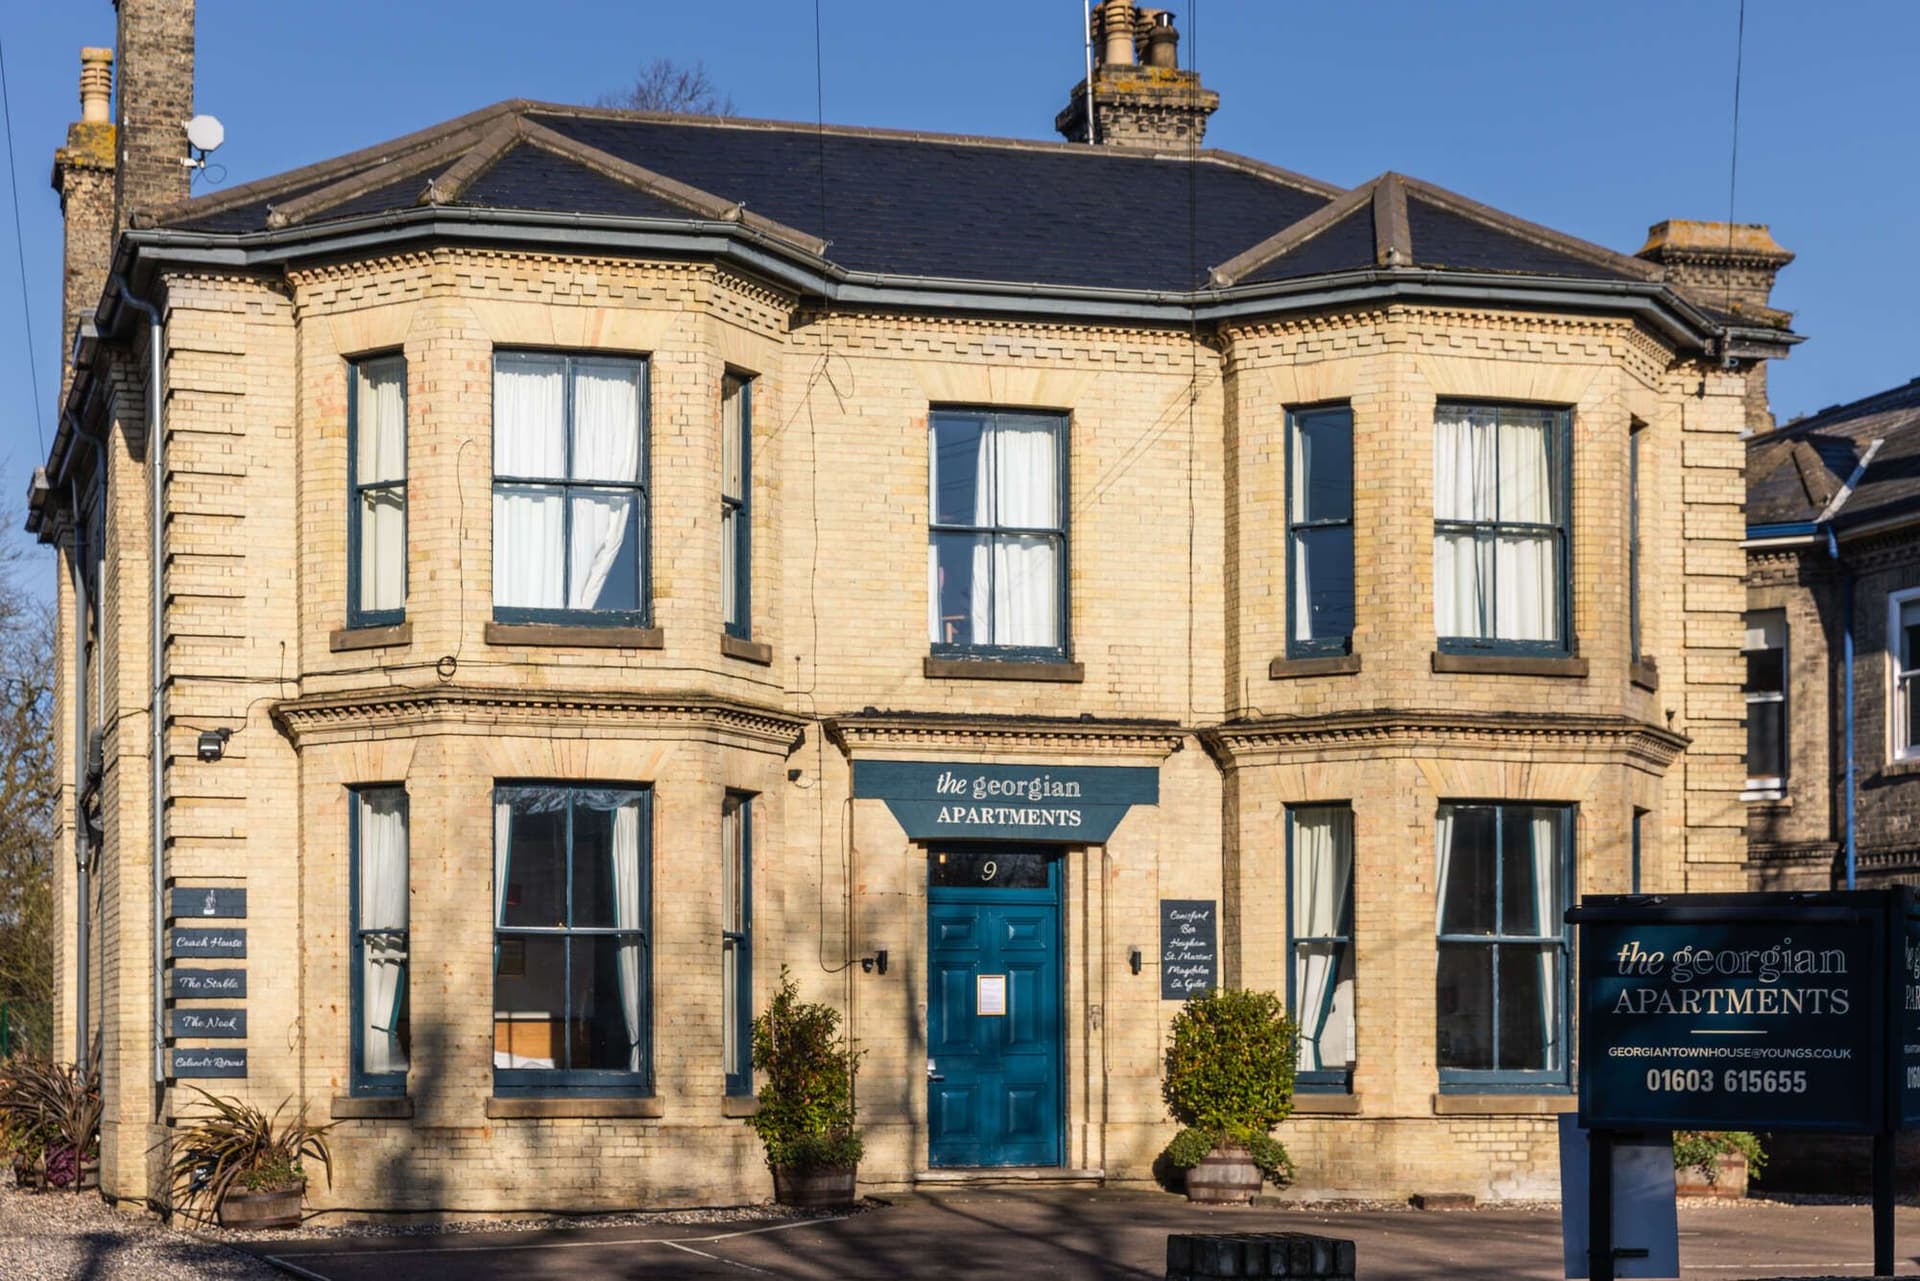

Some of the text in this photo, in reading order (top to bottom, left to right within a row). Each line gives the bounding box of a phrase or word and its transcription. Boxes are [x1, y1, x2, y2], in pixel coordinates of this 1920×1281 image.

[936, 771, 1082, 801] the georgian
[936, 806, 1082, 827] APARTMENTS
[981, 861, 998, 881] 9
[1616, 937, 1849, 983] the georgian
[179, 976, 202, 989] The
[1612, 988, 1850, 1015] APARTMENTS
[182, 1015, 205, 1028] The
[1608, 1046, 1852, 1059] GEORGIANTOWNHOUSE@YOUNGS.CO.UK
[1646, 1069, 1808, 1093] 01603 615655
